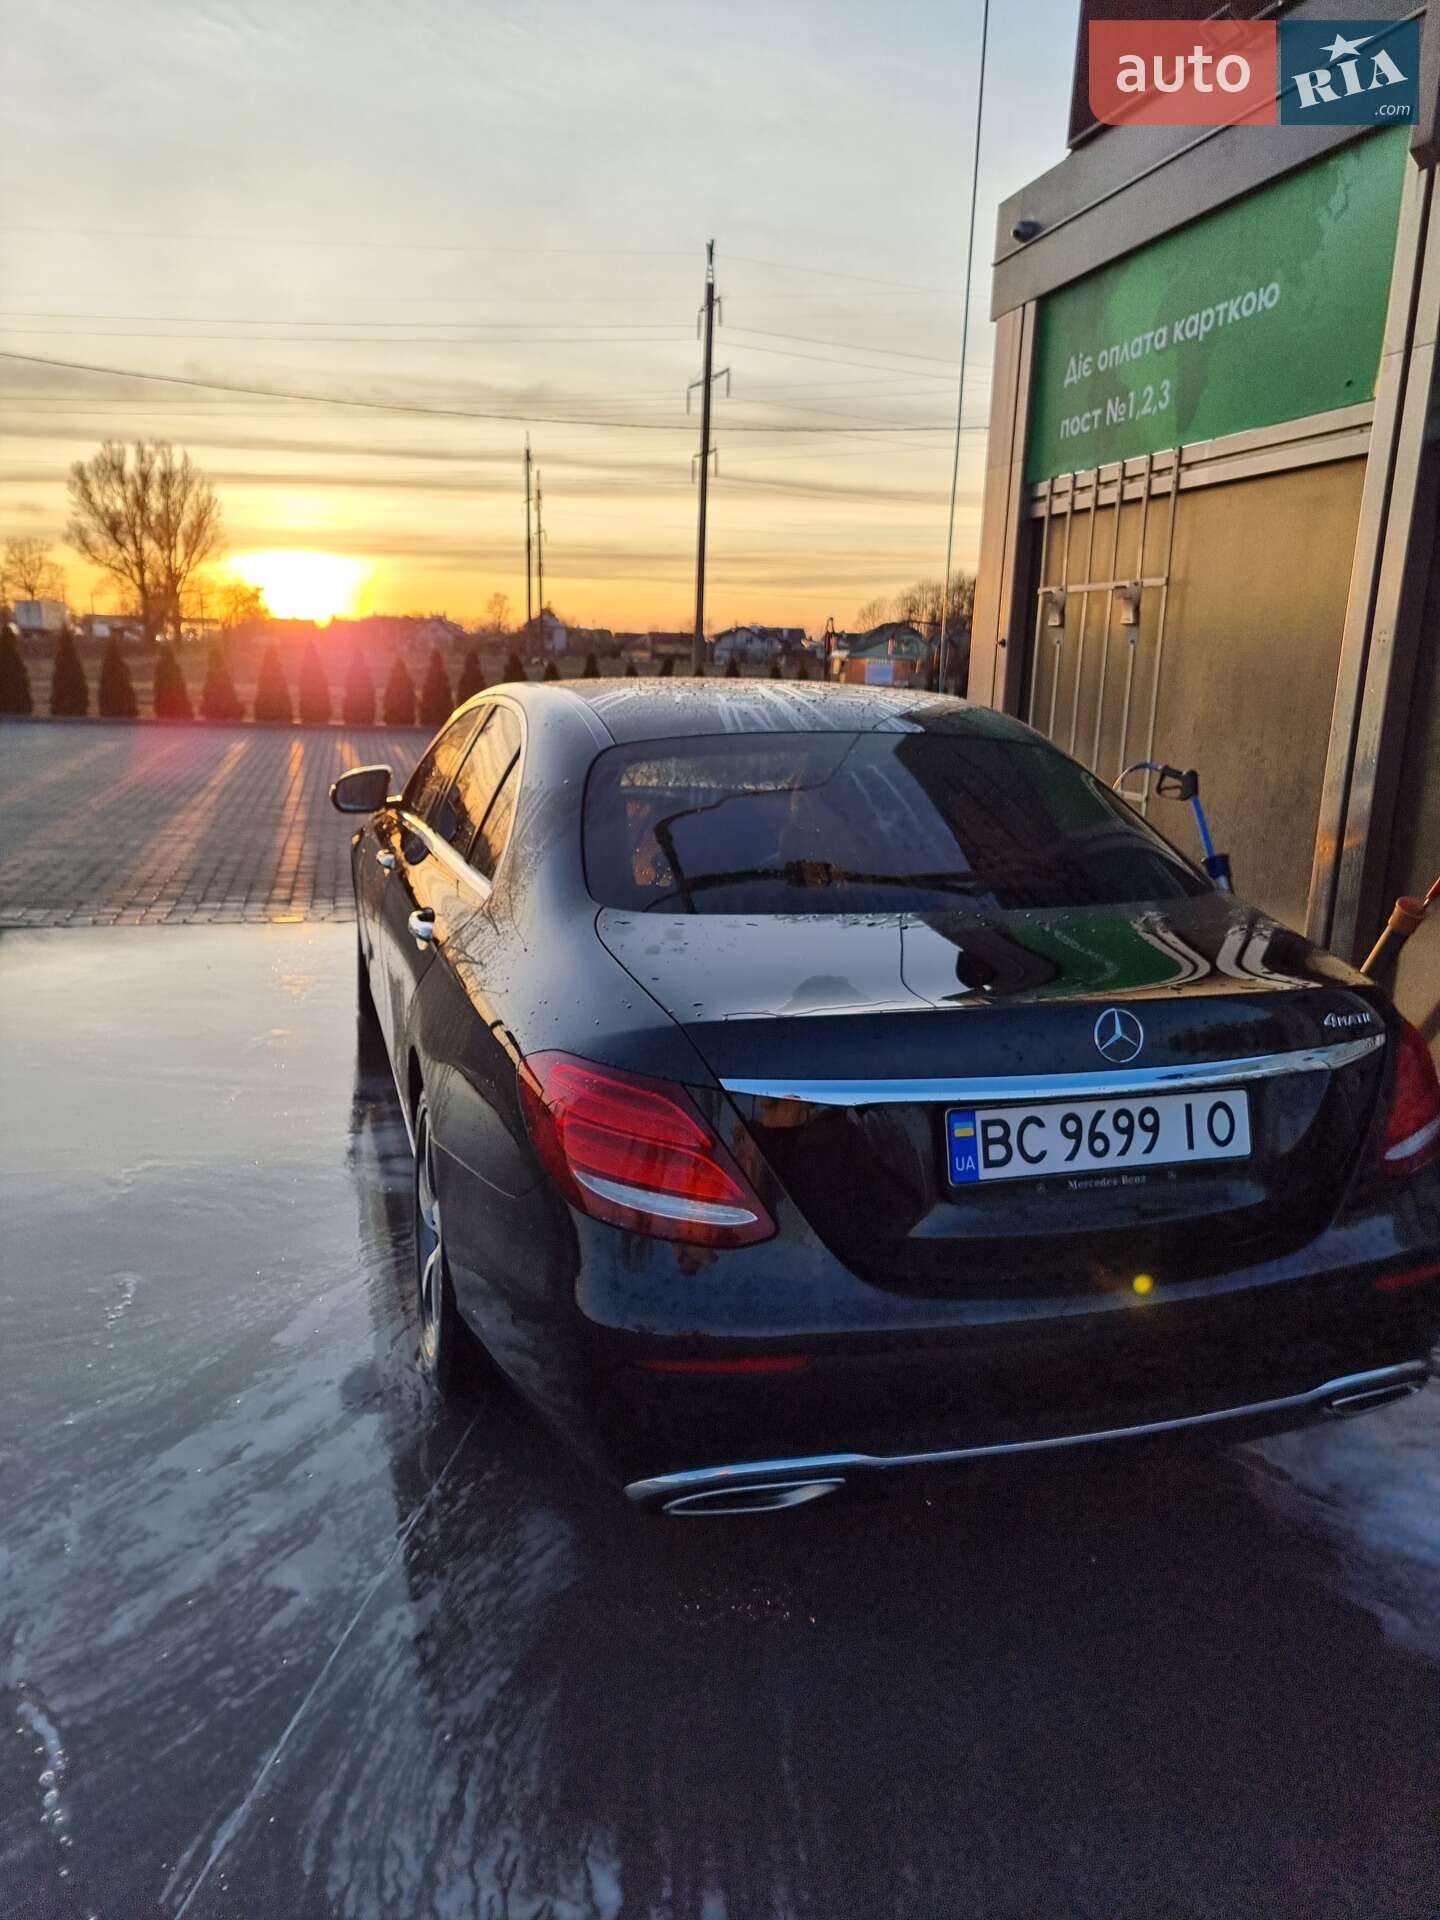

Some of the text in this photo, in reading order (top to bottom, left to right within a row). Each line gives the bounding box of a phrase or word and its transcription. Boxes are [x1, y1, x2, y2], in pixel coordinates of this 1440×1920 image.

[1063, 282, 1281, 388] Діє оплата карткою
[1060, 408, 1102, 440] пост
[981, 1115, 1048, 1169] BC
[1060, 1106, 1161, 1162] 9699
[955, 1157, 976, 1171] UA
